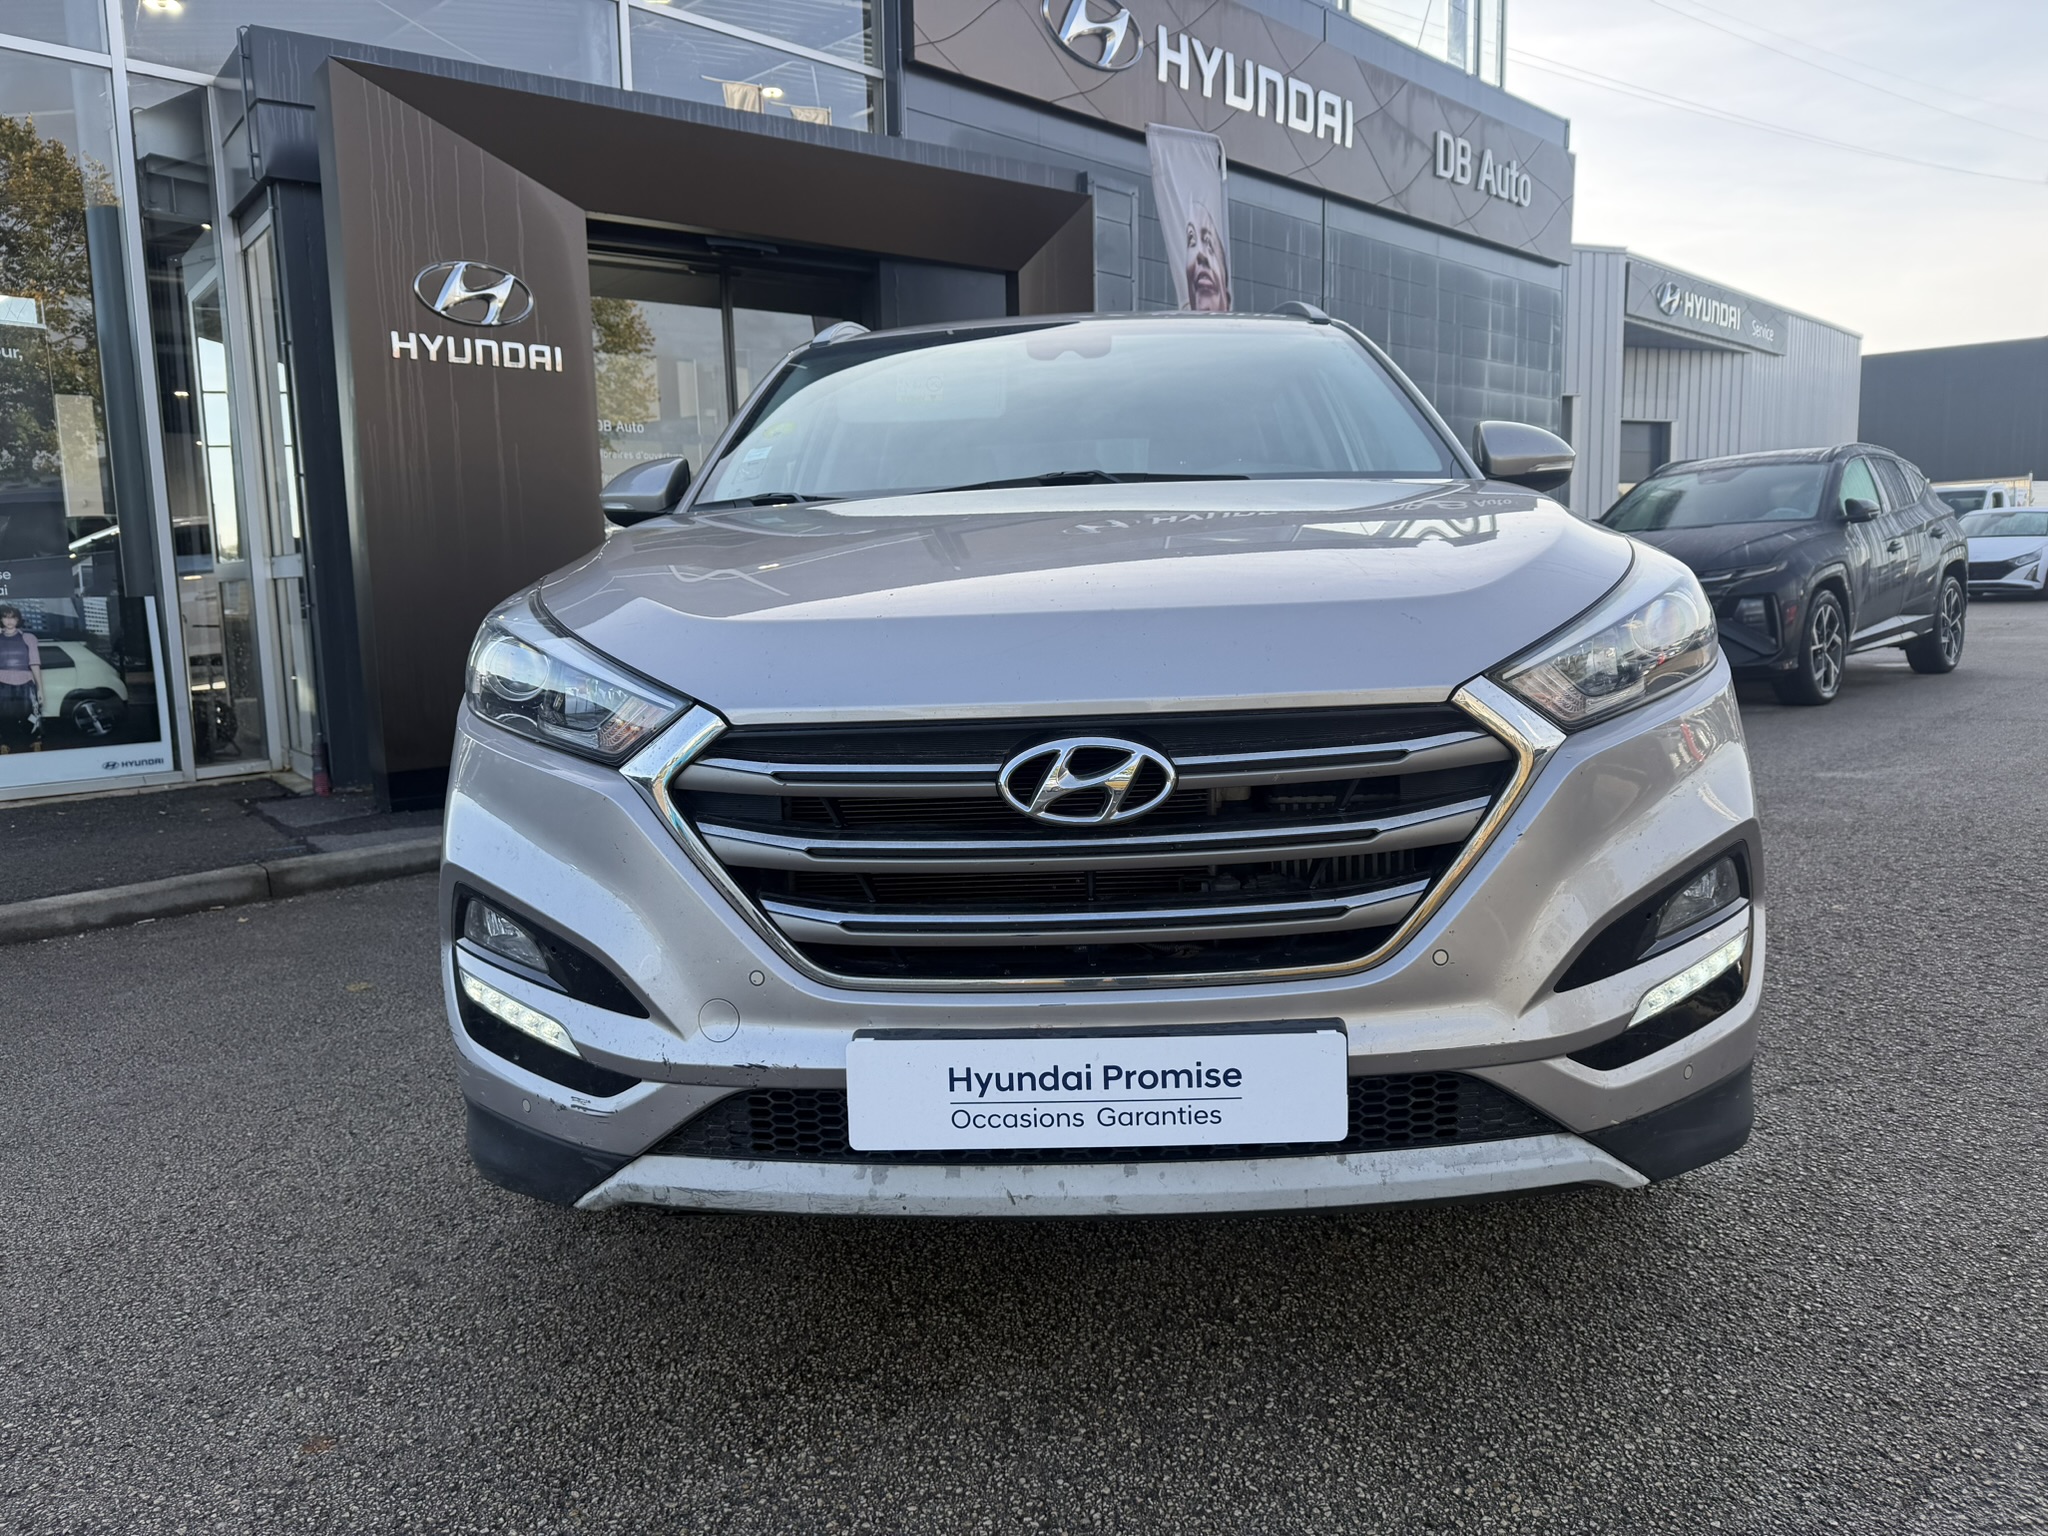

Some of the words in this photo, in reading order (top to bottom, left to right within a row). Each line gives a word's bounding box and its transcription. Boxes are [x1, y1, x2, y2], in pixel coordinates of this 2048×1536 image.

[1157, 24, 1354, 149] HYUNDAI
[1434, 129, 1472, 186] DB
[1476, 147, 1532, 208] Auto
[1684, 291, 1741, 330] HYUNDAI
[1751, 320, 1775, 341] Service
[0, 347, 23, 361] ur,
[390, 330, 563, 372] HYUNDAI
[615, 421, 645, 433] Auto
[121, 758, 164, 767] HYUNDAI
[948, 1063, 1093, 1098] Hyundai
[1102, 1061, 1243, 1090] Promise
[951, 1107, 1085, 1129] Occasions
[1096, 1104, 1223, 1127] Garanties
